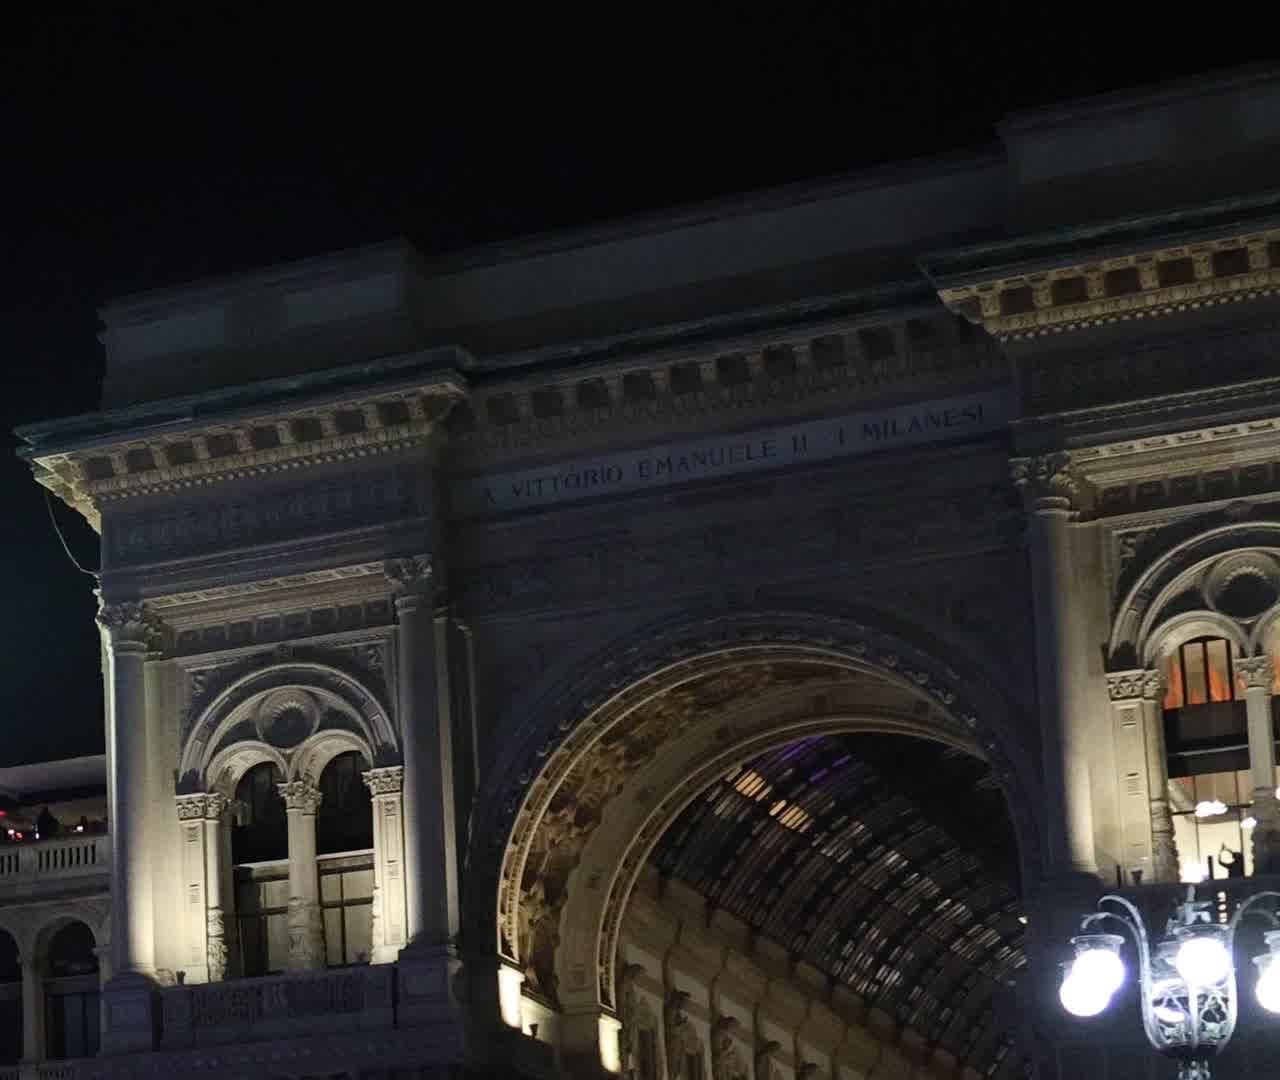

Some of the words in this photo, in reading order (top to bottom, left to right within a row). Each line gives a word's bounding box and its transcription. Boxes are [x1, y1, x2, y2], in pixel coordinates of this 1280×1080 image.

[510, 463, 624, 498] VITTORIO
[638, 439, 778, 480] EMANUELE
[862, 403, 984, 441] MILANESI
